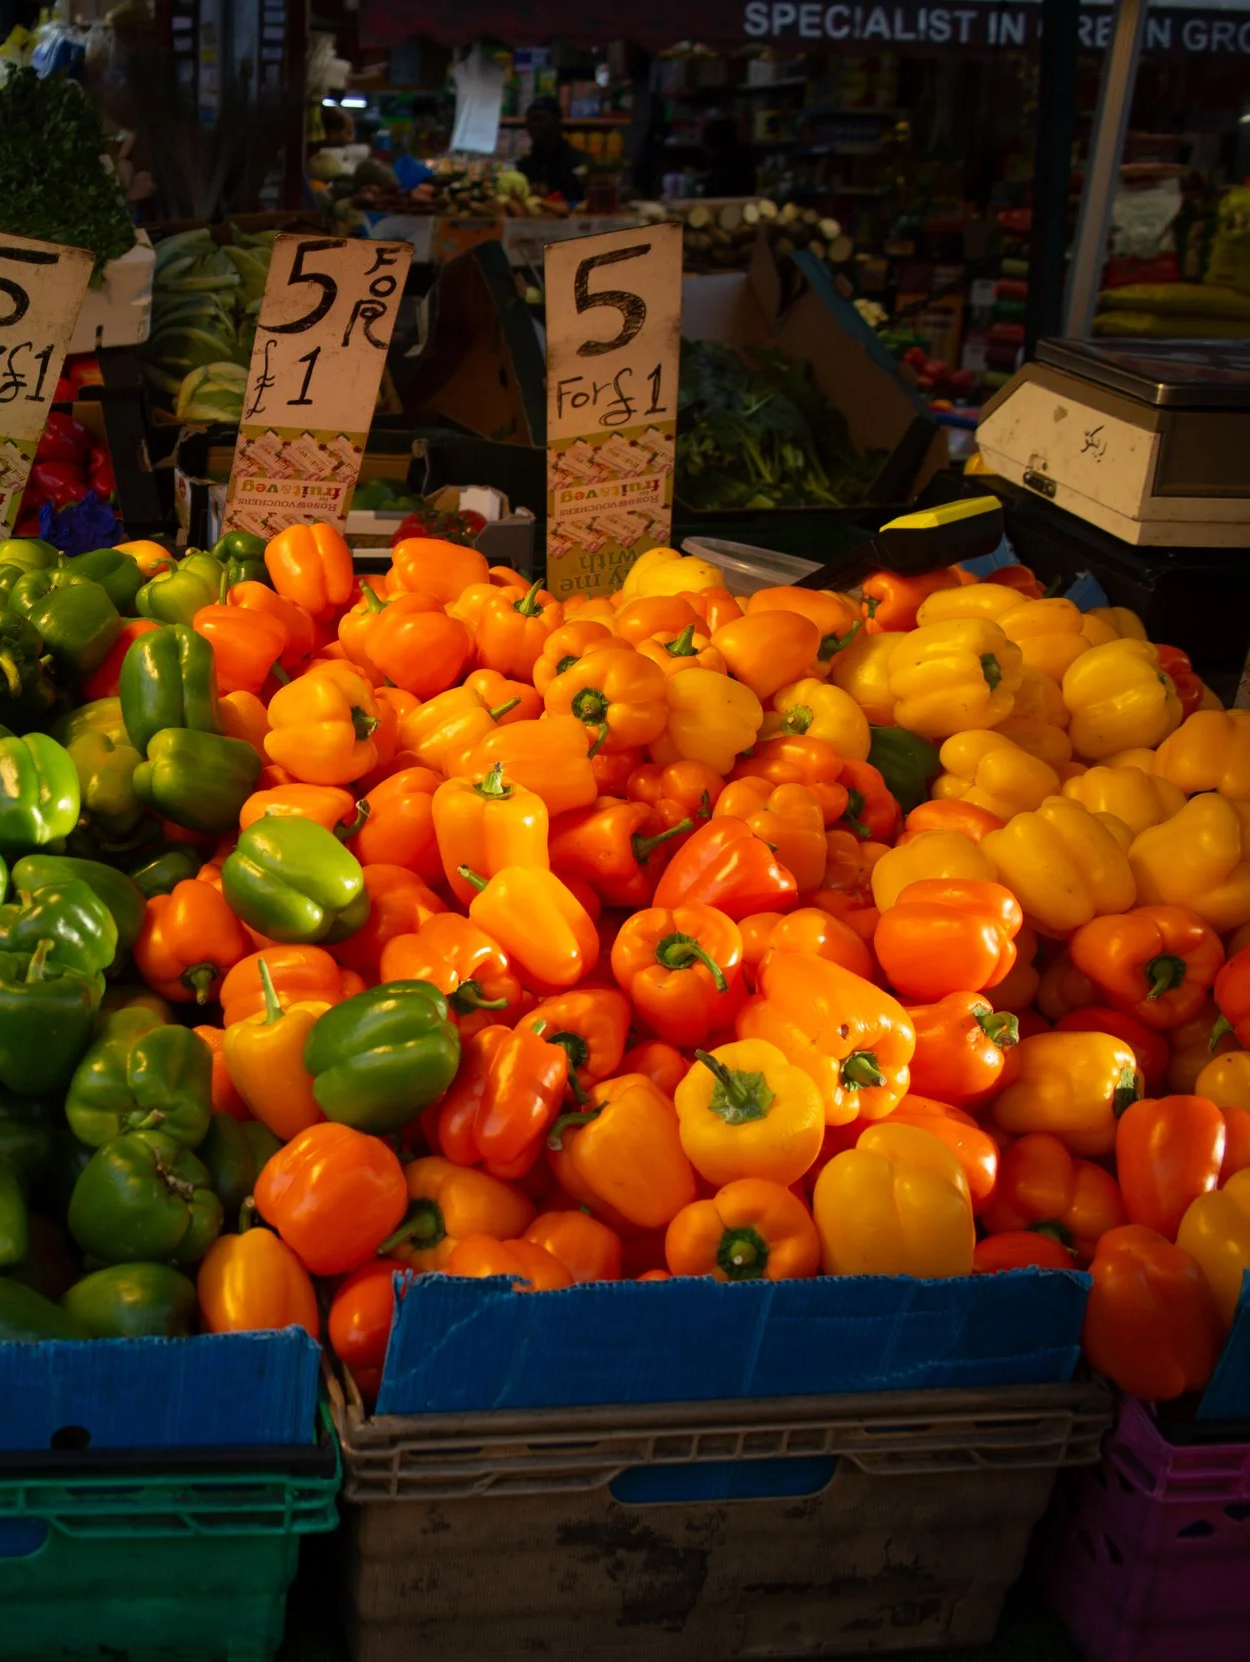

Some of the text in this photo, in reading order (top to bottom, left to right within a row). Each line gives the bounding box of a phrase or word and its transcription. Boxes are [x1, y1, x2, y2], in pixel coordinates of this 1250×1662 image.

[743, 2, 978, 44] SPECIALIST
[987, 10, 1026, 45] IN
[1037, 14, 1172, 49] REN
[258, 239, 347, 333] 5
[574, 243, 651, 357] 5
[558, 376, 611, 419] For
[578, 549, 639, 573] with
